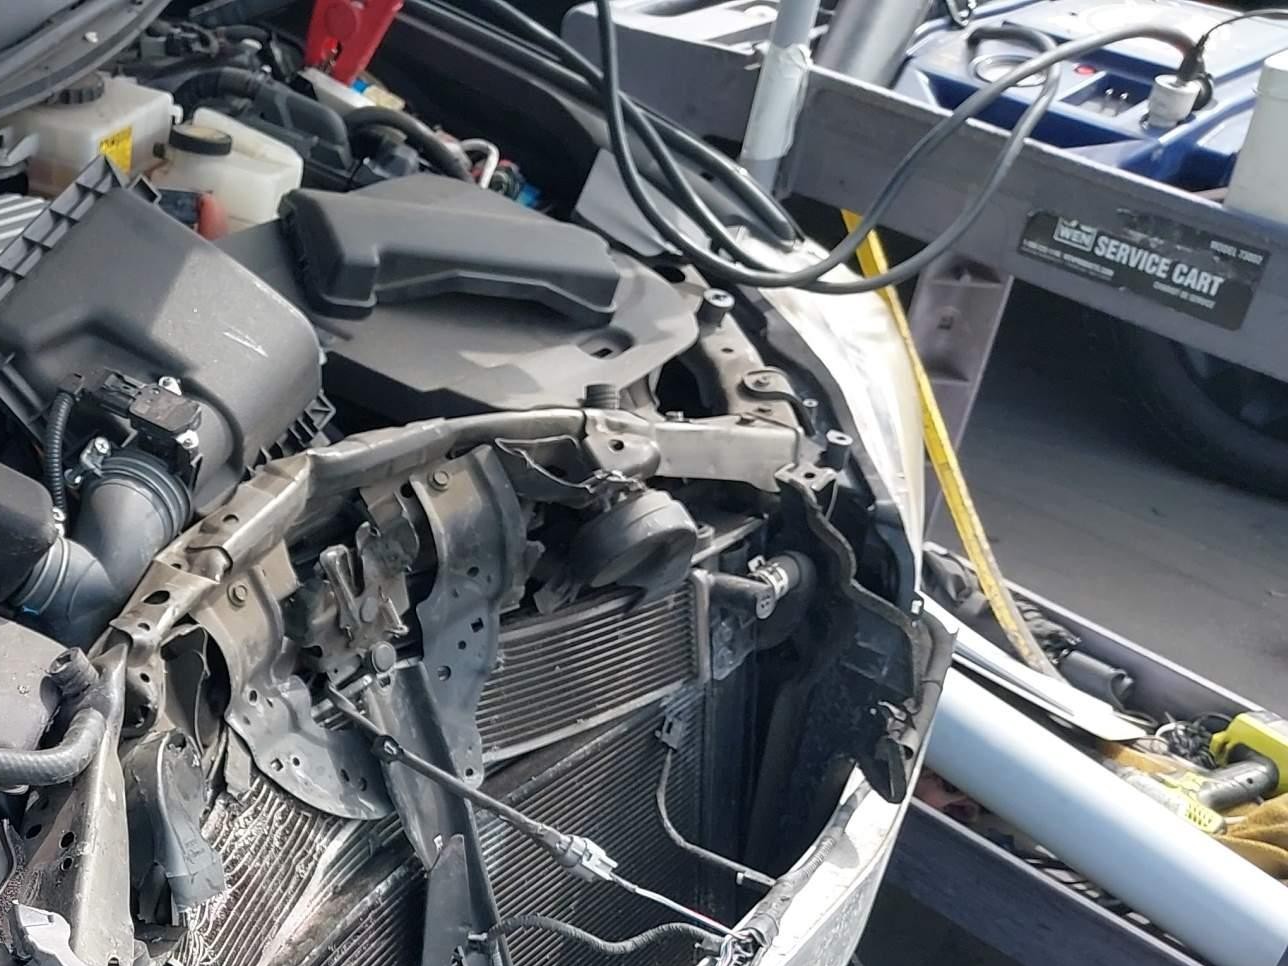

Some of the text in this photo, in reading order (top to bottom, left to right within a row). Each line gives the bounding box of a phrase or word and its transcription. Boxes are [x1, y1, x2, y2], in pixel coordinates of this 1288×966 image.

[1058, 227, 1094, 247] WEN
[1093, 235, 1170, 279] SERVICE
[1171, 263, 1225, 297] CART
